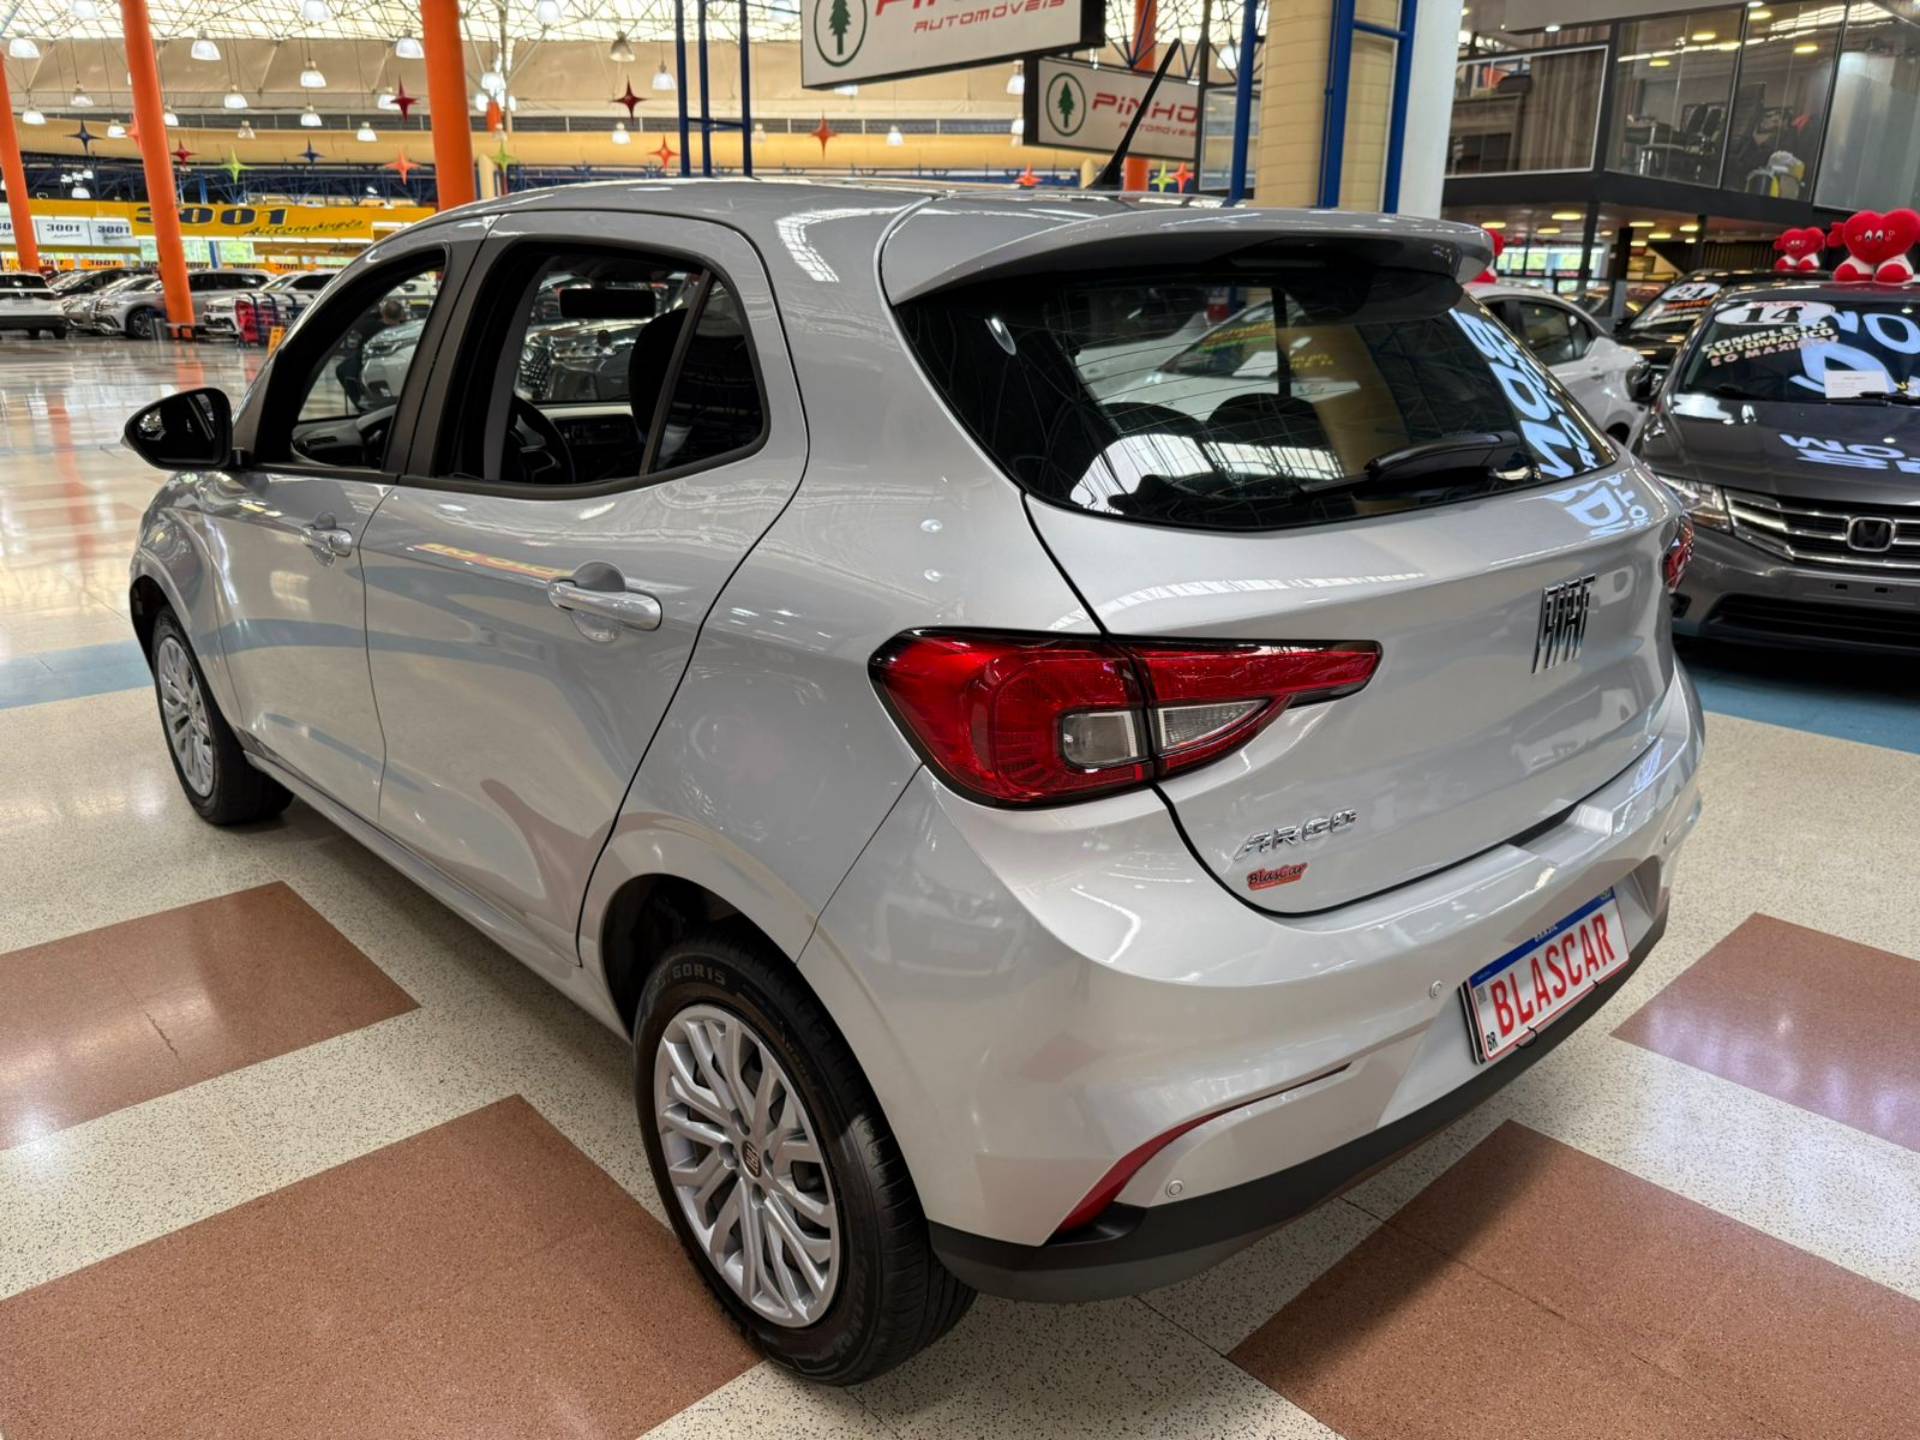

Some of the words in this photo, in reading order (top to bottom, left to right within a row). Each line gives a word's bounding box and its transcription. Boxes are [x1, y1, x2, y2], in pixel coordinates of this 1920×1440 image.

[46, 223, 80, 232] 3001
[1742, 306, 1803, 323] 14
[1233, 809, 1357, 861] ARGO
[1490, 913, 1616, 1038] BLASCAR
